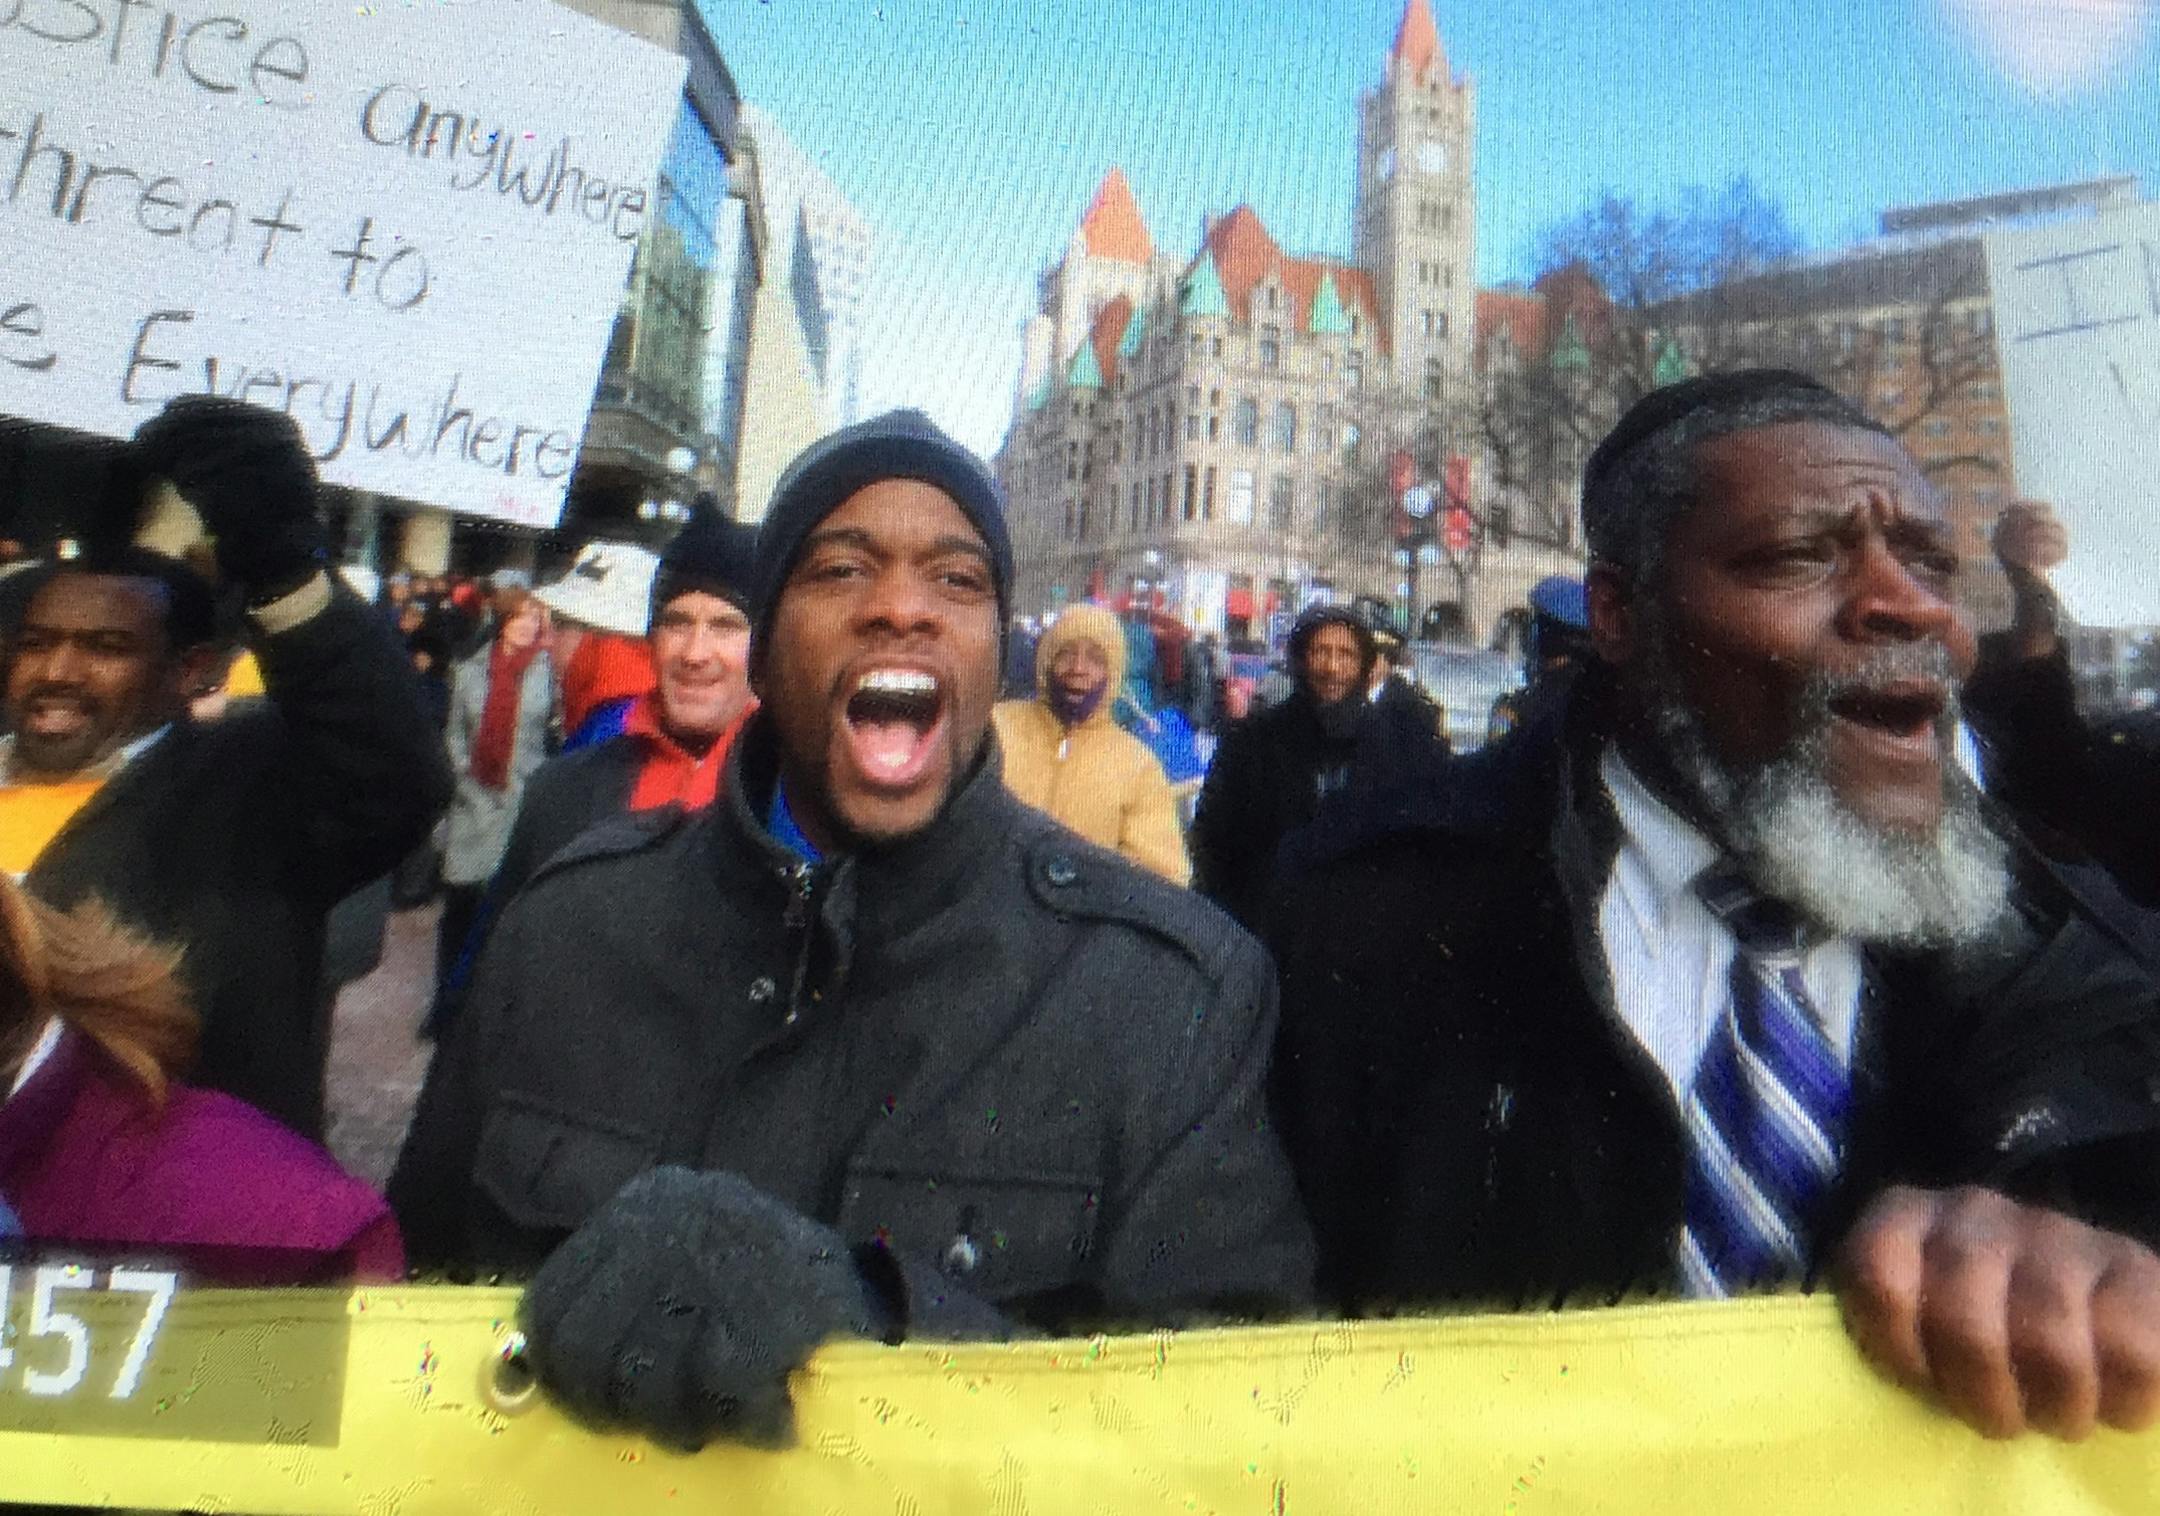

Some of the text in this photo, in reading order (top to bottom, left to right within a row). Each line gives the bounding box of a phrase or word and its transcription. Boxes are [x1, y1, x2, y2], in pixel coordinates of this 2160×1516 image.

[0, 0, 648, 241] stice anywhere
[331, 216, 431, 312] to
[121, 309, 573, 480] Everywhere
